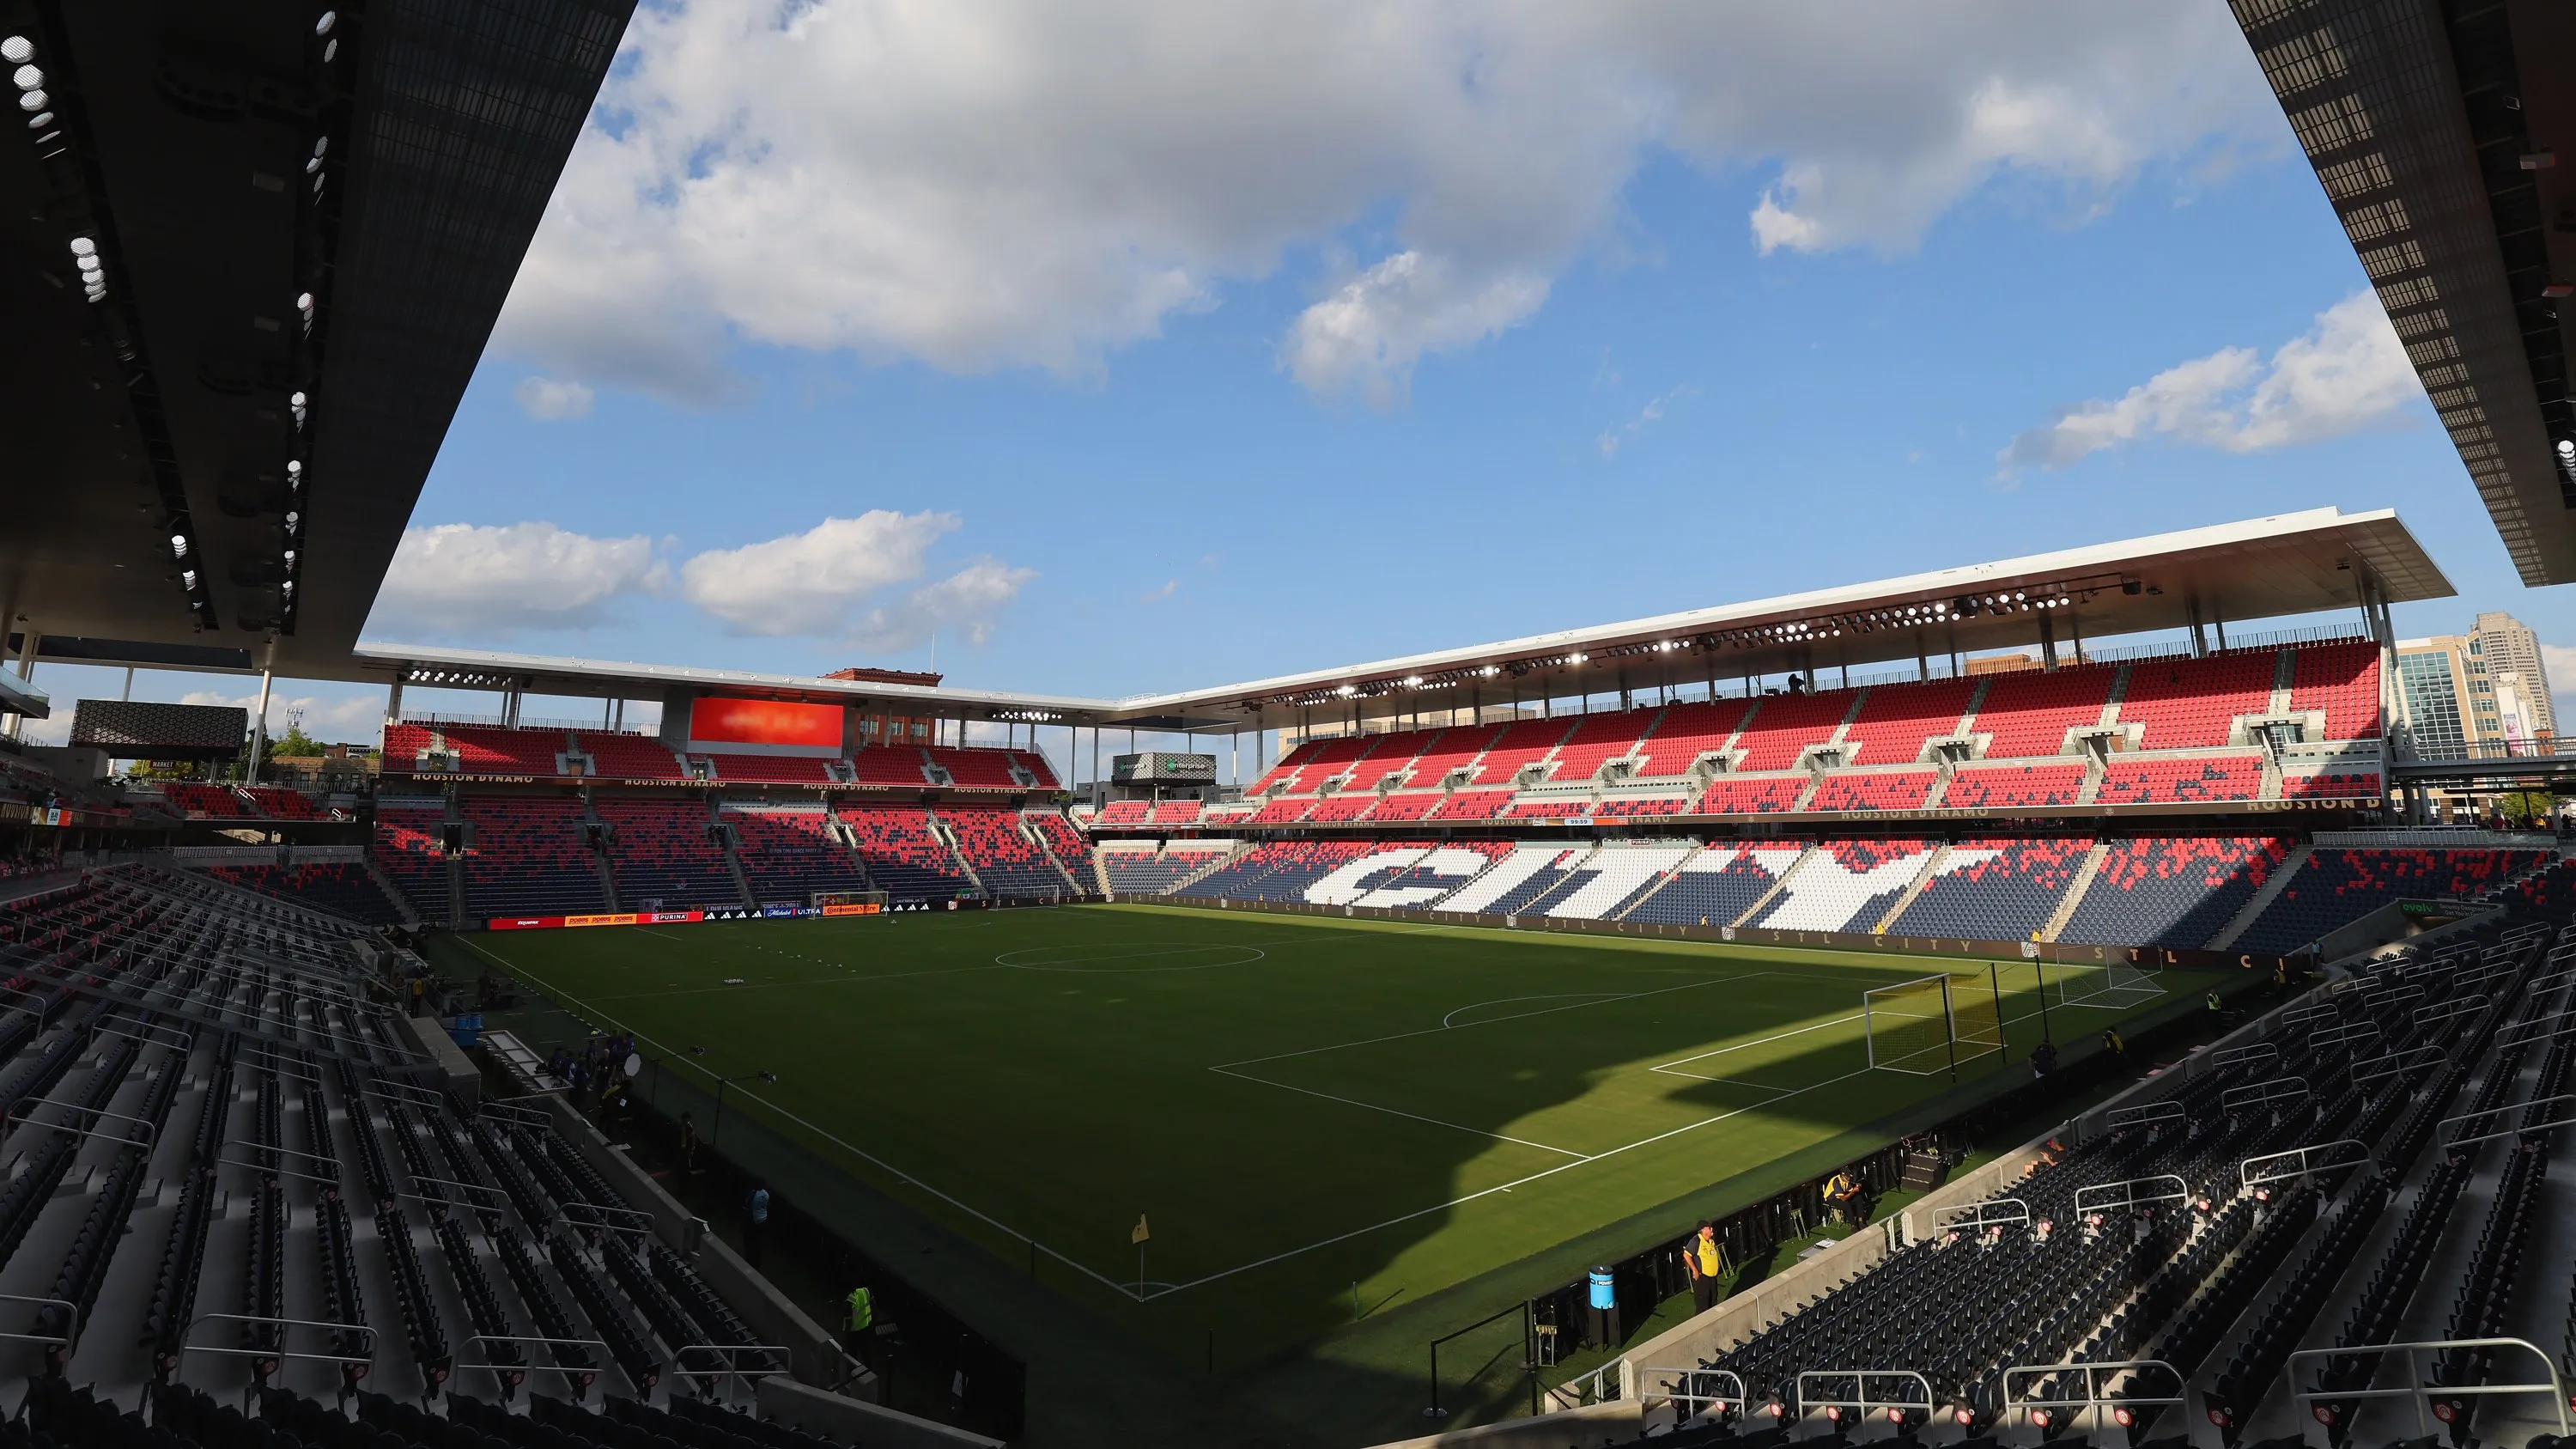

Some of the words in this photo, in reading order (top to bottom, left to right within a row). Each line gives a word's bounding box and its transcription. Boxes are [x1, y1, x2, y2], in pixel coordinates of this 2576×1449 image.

[2246, 799, 2355, 811] HOUSTON
[1841, 810, 1911, 819] HOUSTON
[1918, 809, 1989, 819] DYNAMO
[1286, 904, 1326, 913] CITY
[2403, 903, 2433, 912] evolv
[1375, 909, 1406, 918] STL
[1430, 913, 1480, 923] CITY
[1546, 919, 1586, 929] STL
[1618, 922, 1687, 935] CITY
[1774, 931, 1831, 944] STL
[1874, 936, 1970, 952] CITY
[2095, 947, 2177, 964] STL
[2240, 954, 2284, 971] CI
